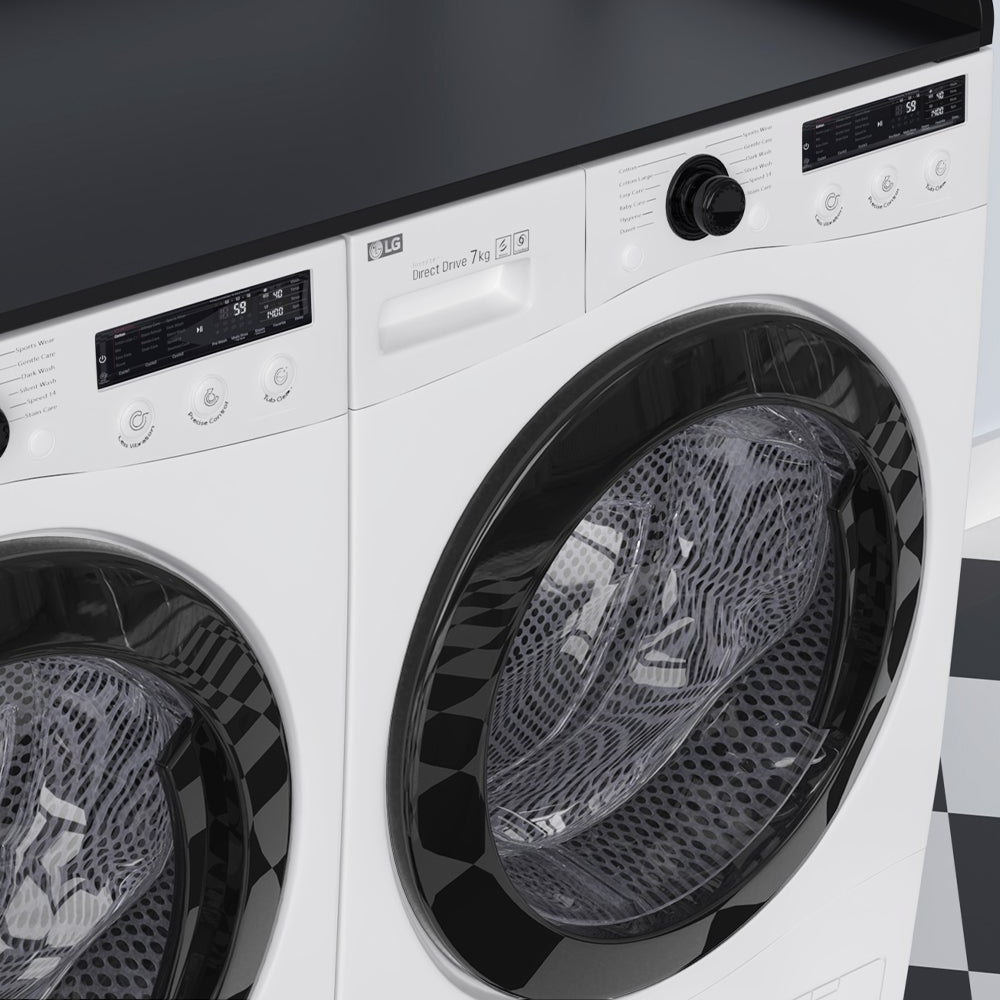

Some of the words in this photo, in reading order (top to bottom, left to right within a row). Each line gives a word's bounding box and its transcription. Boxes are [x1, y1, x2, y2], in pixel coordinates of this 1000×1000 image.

[905, 100, 917, 113] 59
[412, 265, 440, 281] Direct
[442, 257, 468, 273] Drive
[272, 289, 283, 299] 40
[233, 301, 247, 316] 59
[266, 306, 284, 319] 1400
[15, 344, 37, 354] Sports
[20, 371, 37, 380] Dark
[37, 364, 56, 375] Wash
[39, 378, 57, 388] Wash
[26, 393, 48, 404] Speed
[264, 394, 276, 403] Tub
[188, 411, 208, 426] Precise
[208, 401, 229, 424] Control
